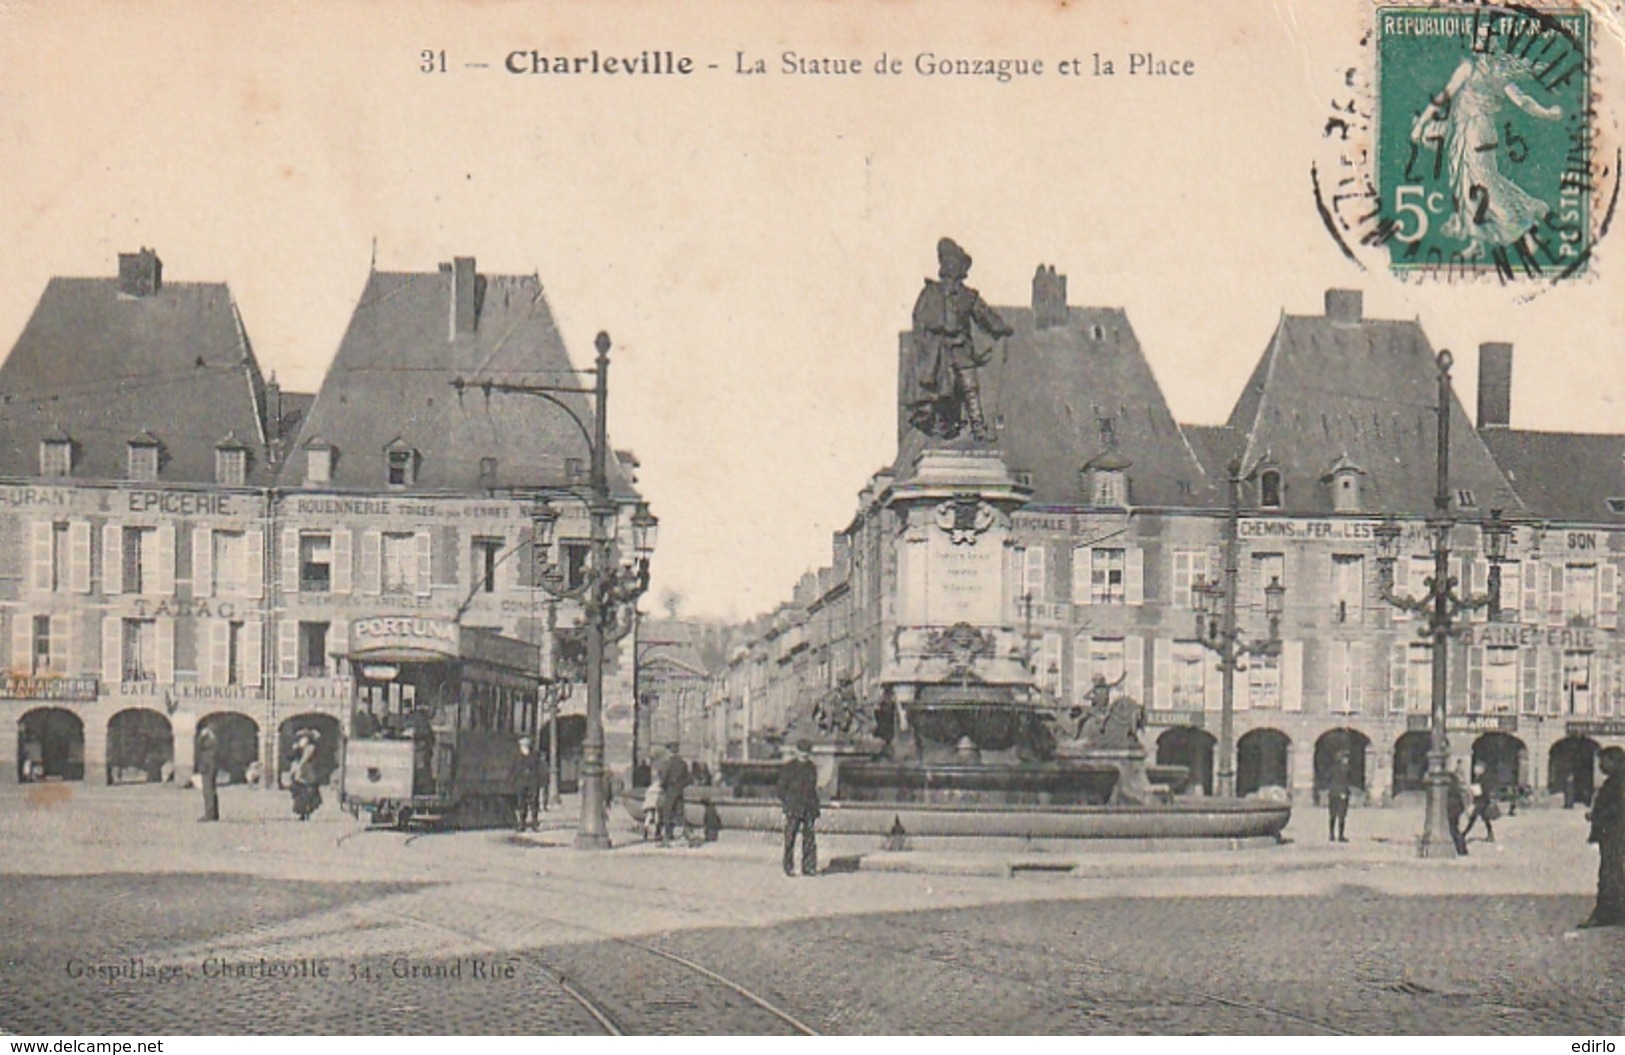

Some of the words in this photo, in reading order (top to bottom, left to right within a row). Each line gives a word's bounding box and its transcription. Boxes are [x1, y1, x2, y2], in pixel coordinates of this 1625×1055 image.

[1240, 520, 1296, 537] CHEMINS
[1306, 522, 1333, 538] FER
[1567, 532, 1597, 549] SON
[134, 599, 235, 618] TABAC
